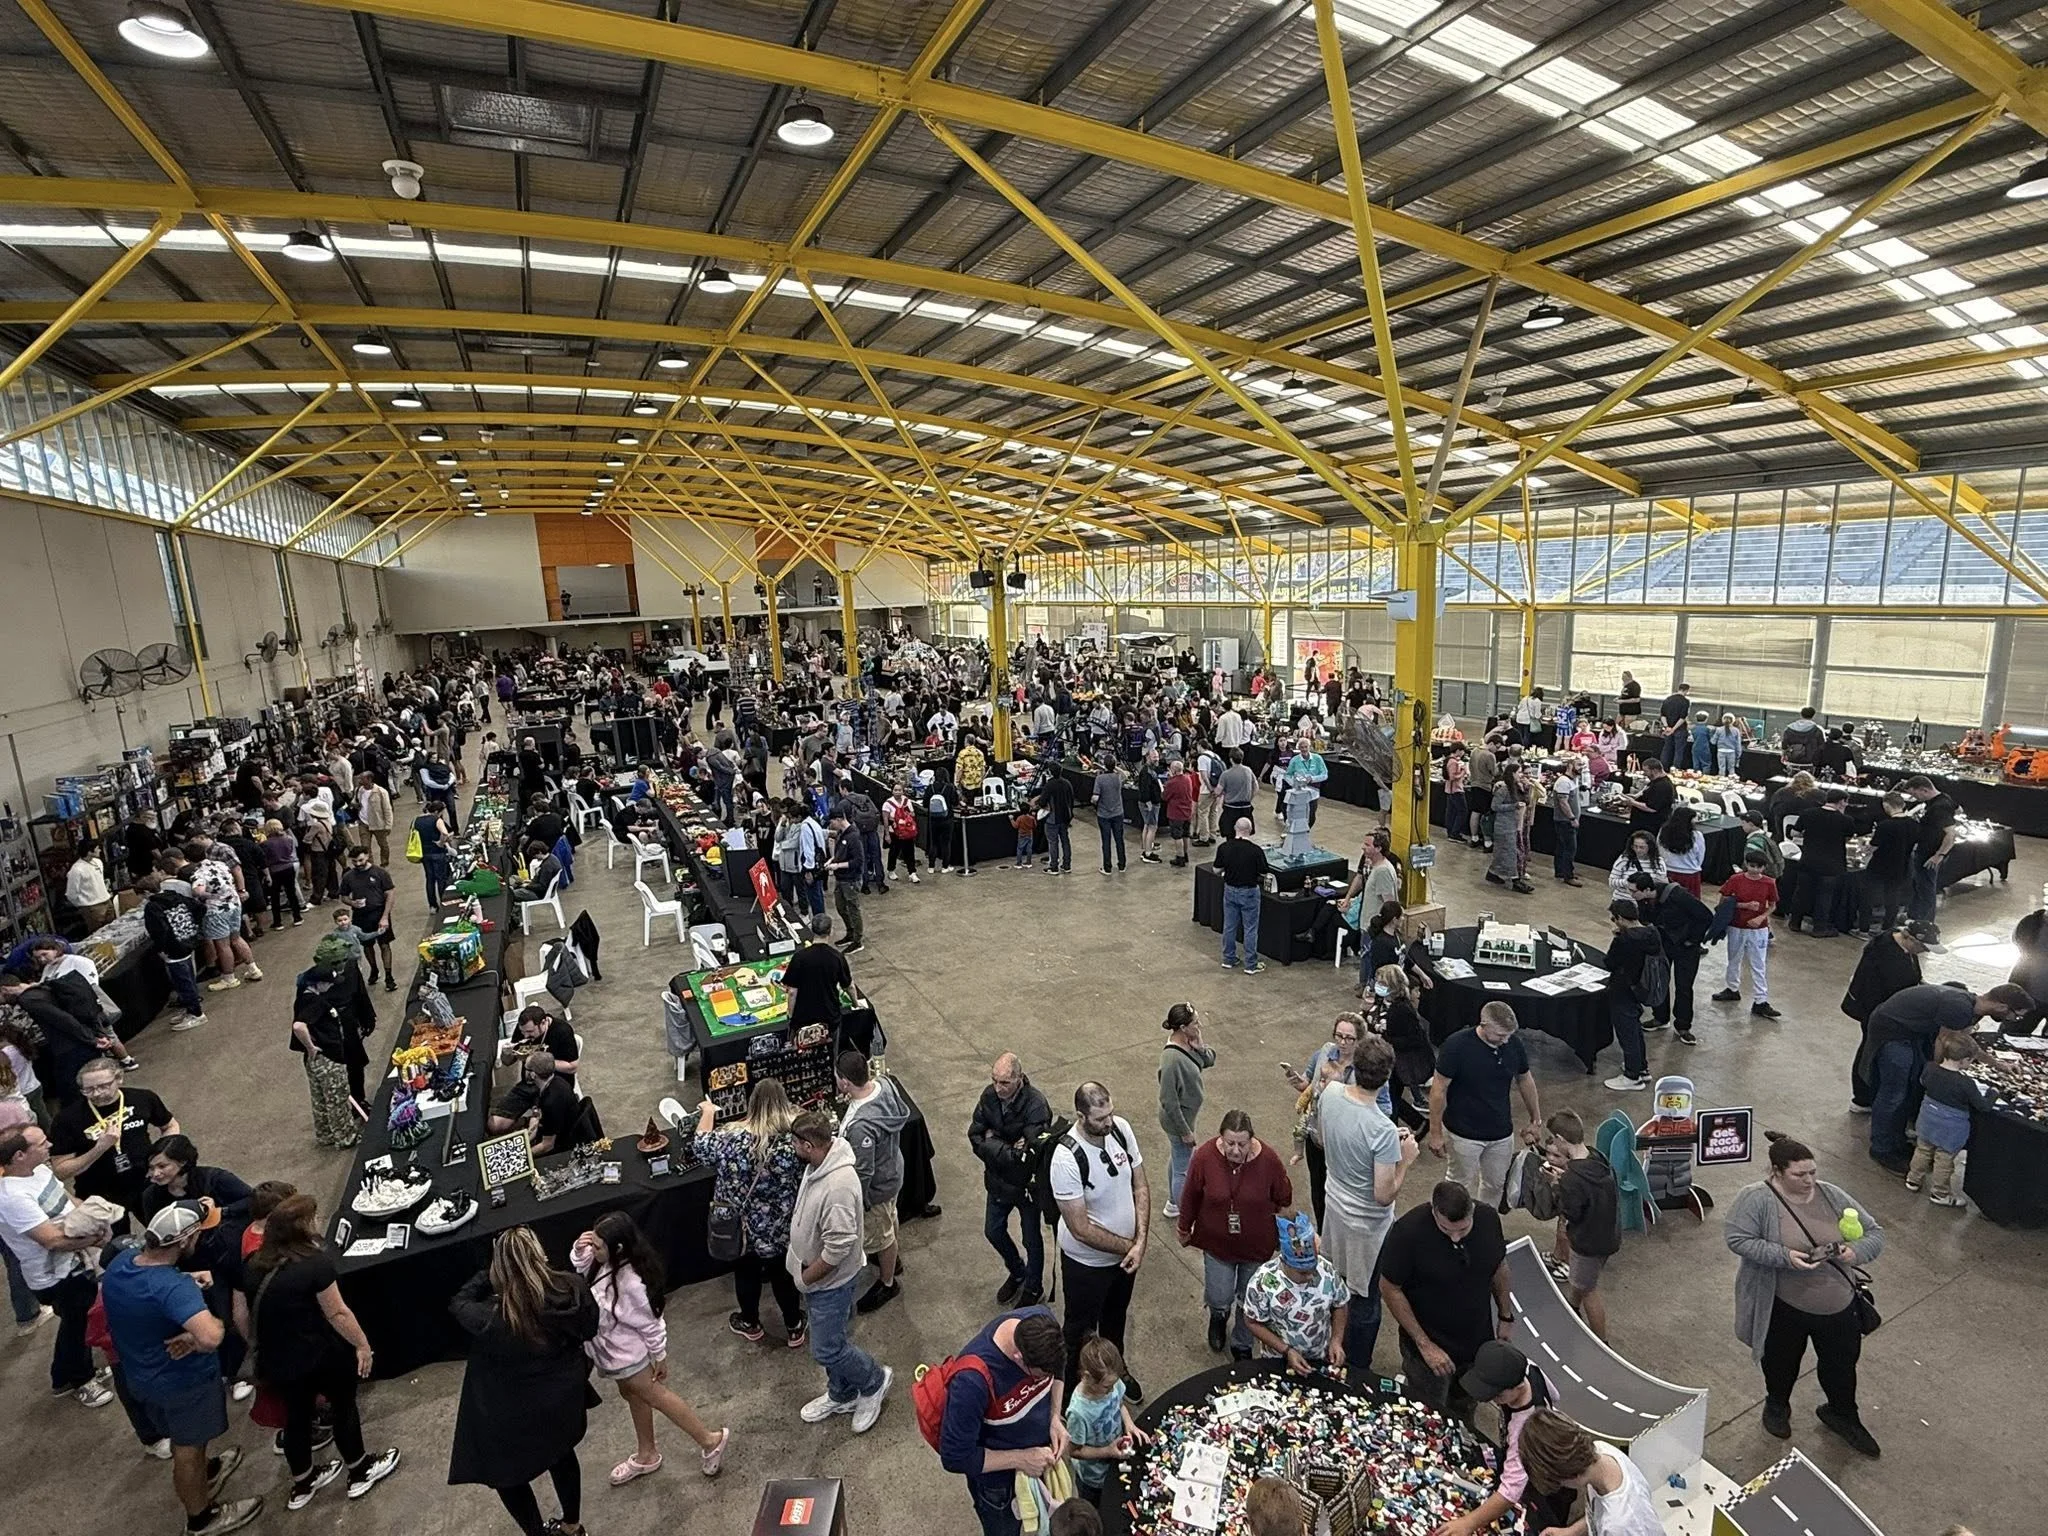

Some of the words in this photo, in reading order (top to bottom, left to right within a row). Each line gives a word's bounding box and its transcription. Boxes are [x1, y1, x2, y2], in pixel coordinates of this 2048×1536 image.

[758, 827, 770, 839] 17
[1712, 1127, 1736, 1138] Get
[1709, 1136, 1739, 1147] Race
[1705, 1142, 1745, 1156] Ready
[1309, 1468, 1340, 1477] ATTENTION
